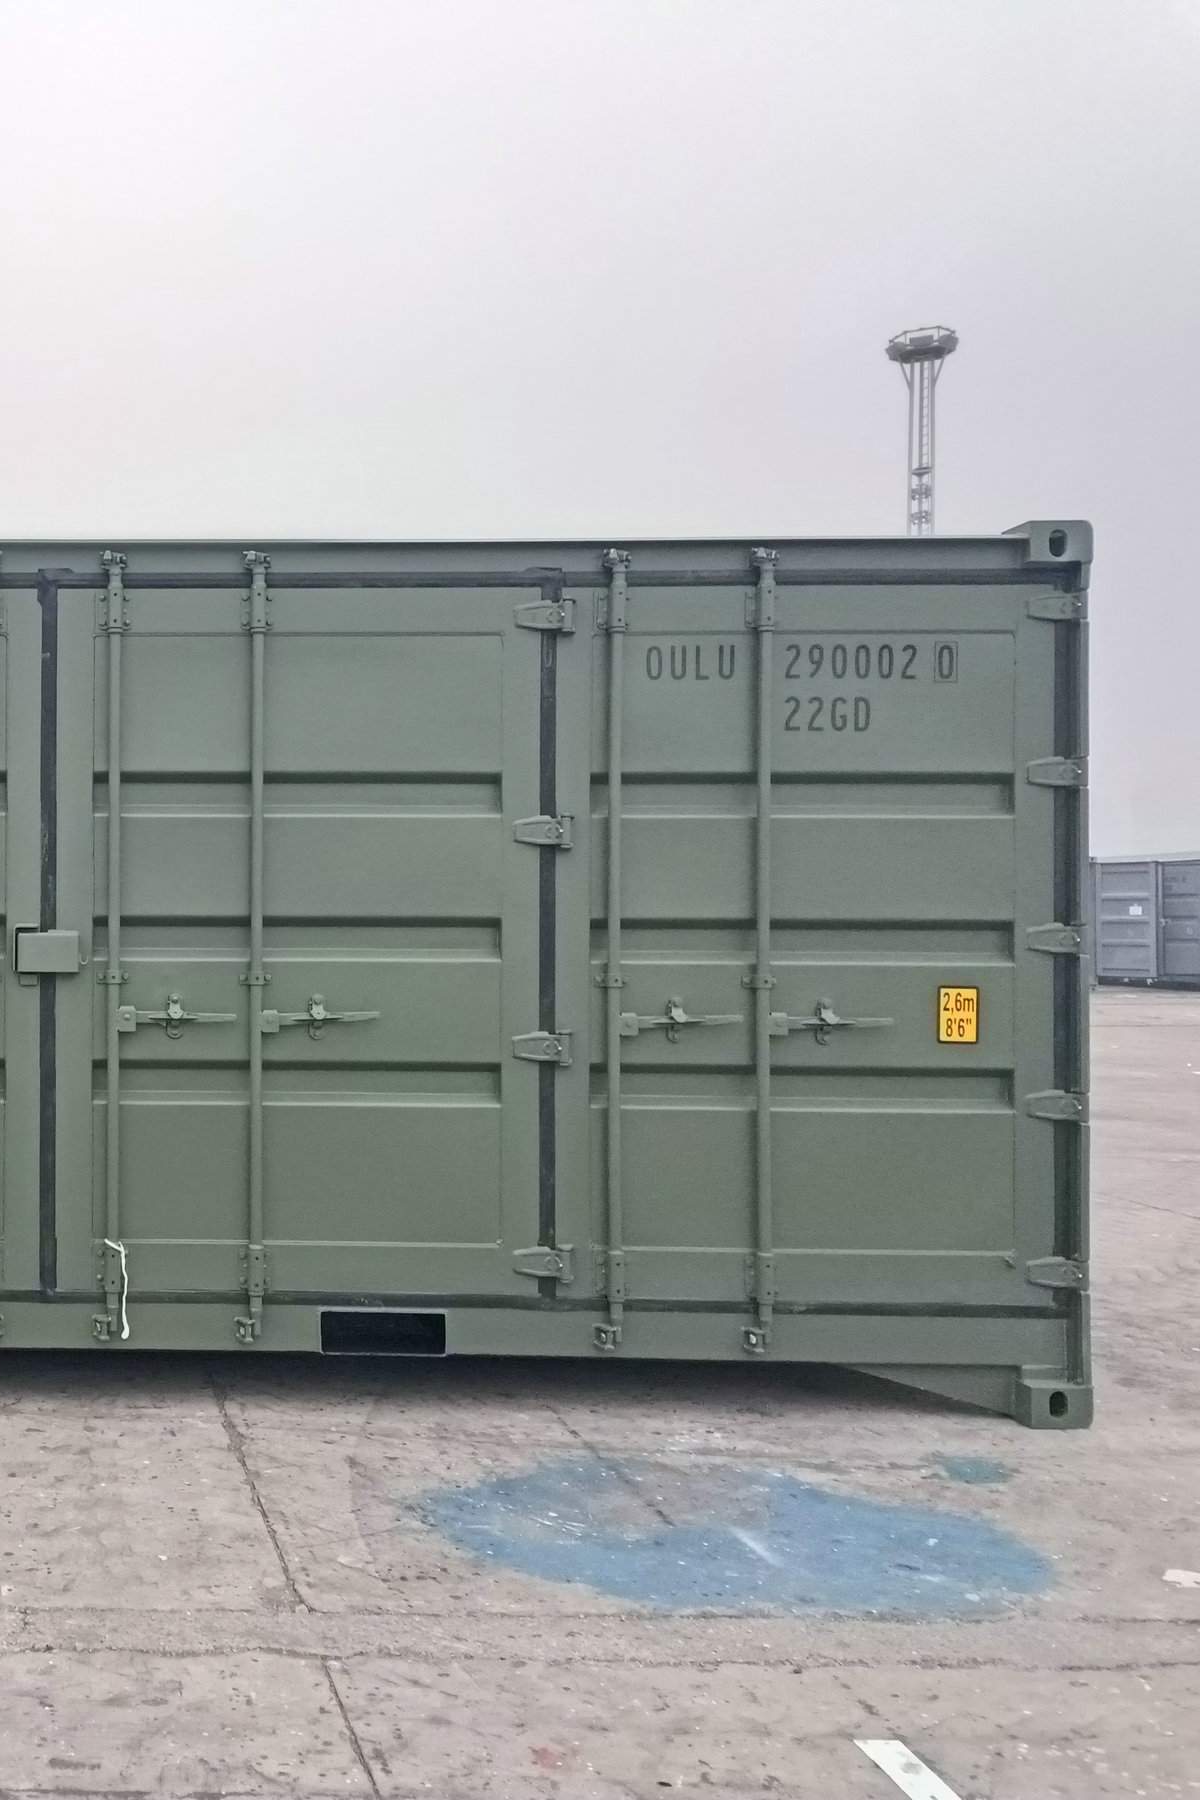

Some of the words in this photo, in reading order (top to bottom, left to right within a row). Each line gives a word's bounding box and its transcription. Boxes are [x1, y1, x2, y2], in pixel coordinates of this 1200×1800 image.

[645, 645, 736, 681] OULU
[784, 644, 918, 680] 290002
[937, 644, 955, 679] 0
[784, 696, 871, 731] 22GD
[943, 992, 975, 1014] 2,6m
[945, 1018, 972, 1038] 8'6"
